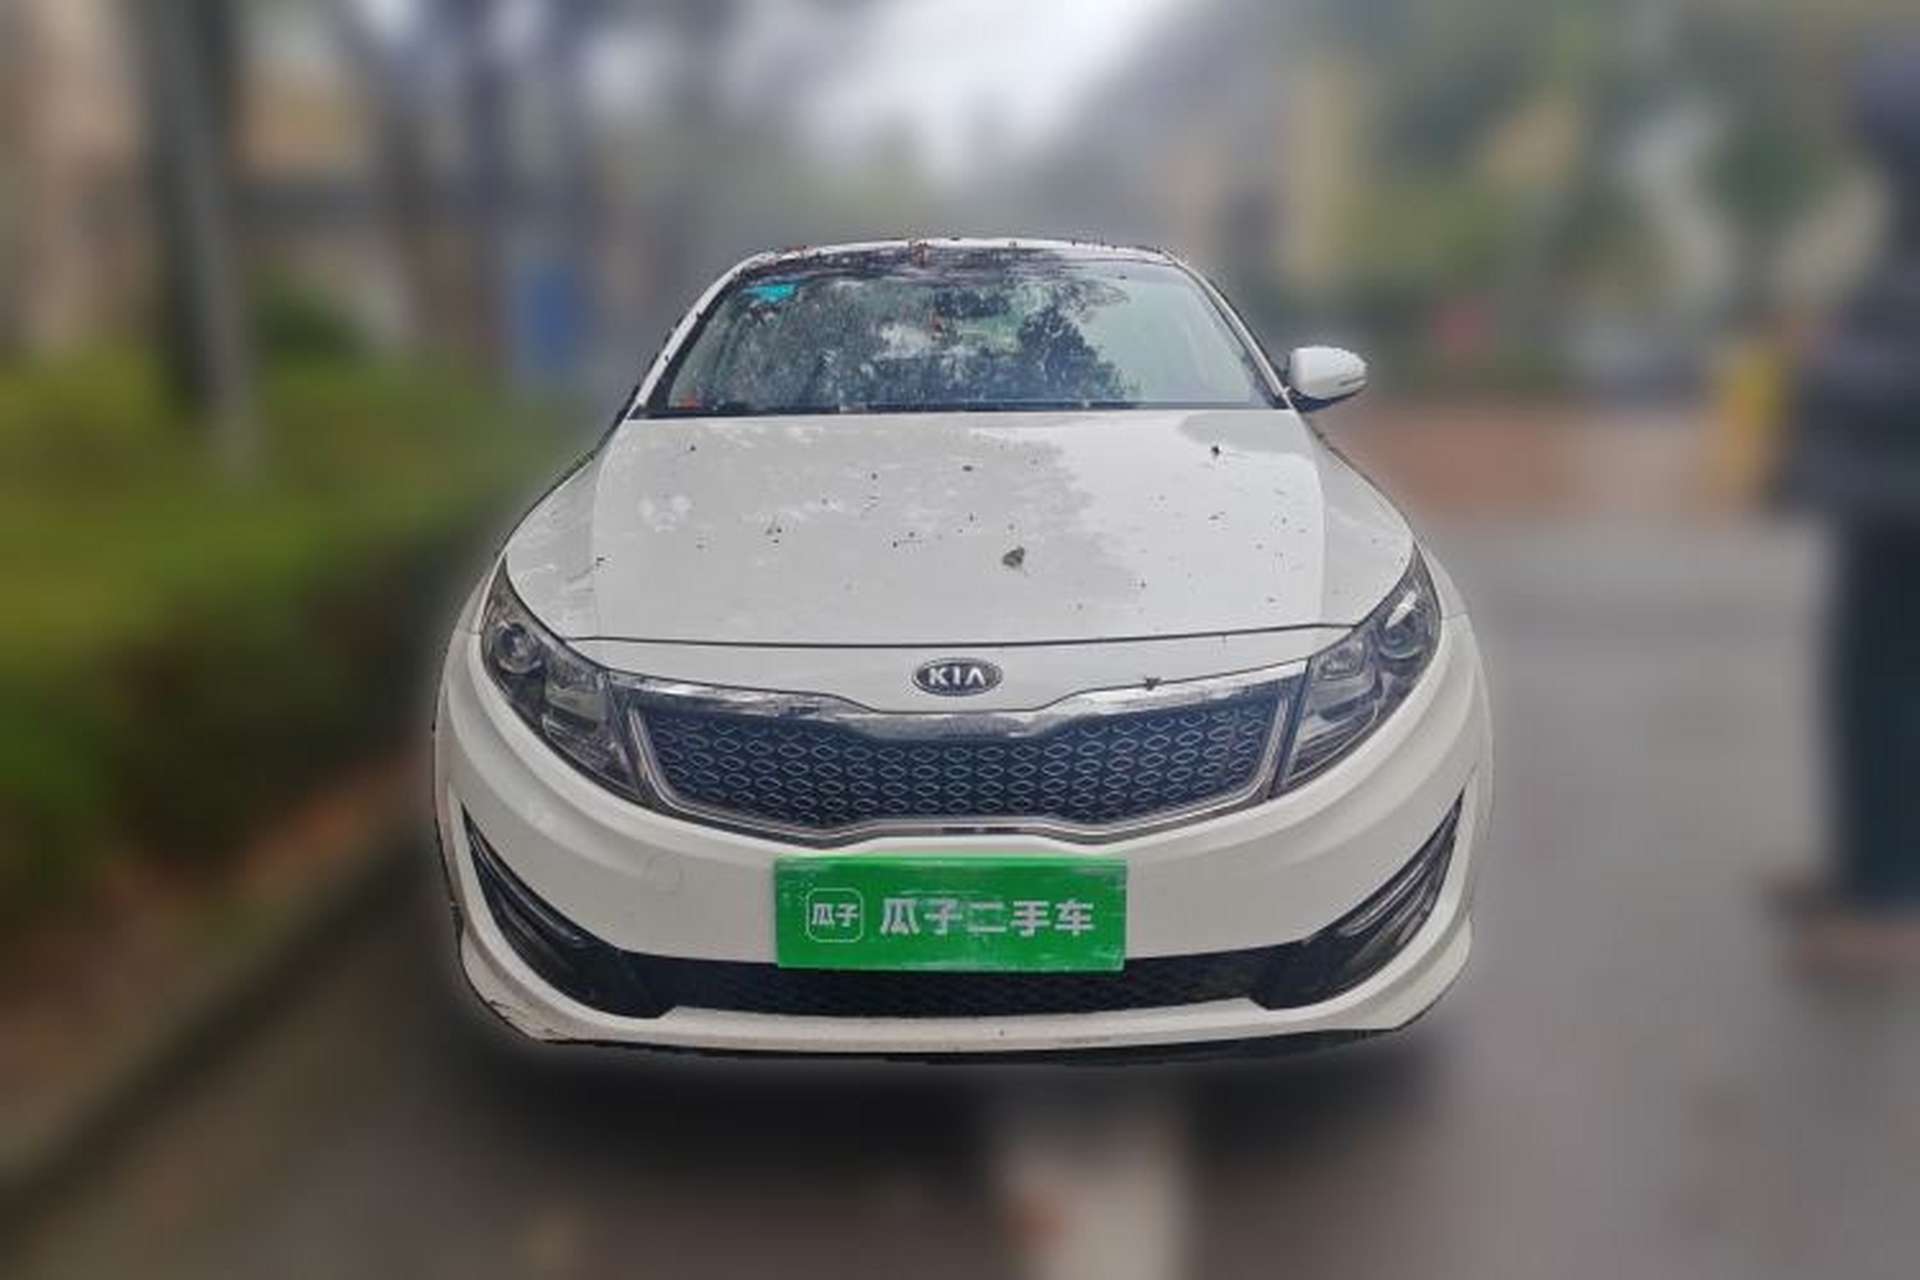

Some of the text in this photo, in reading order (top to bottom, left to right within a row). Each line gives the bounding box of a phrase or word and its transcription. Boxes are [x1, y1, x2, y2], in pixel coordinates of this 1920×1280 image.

[929, 666, 985, 686] KIA
[811, 902, 859, 926] 瓜子
[880, 898, 1095, 936] 瓜子二手车
